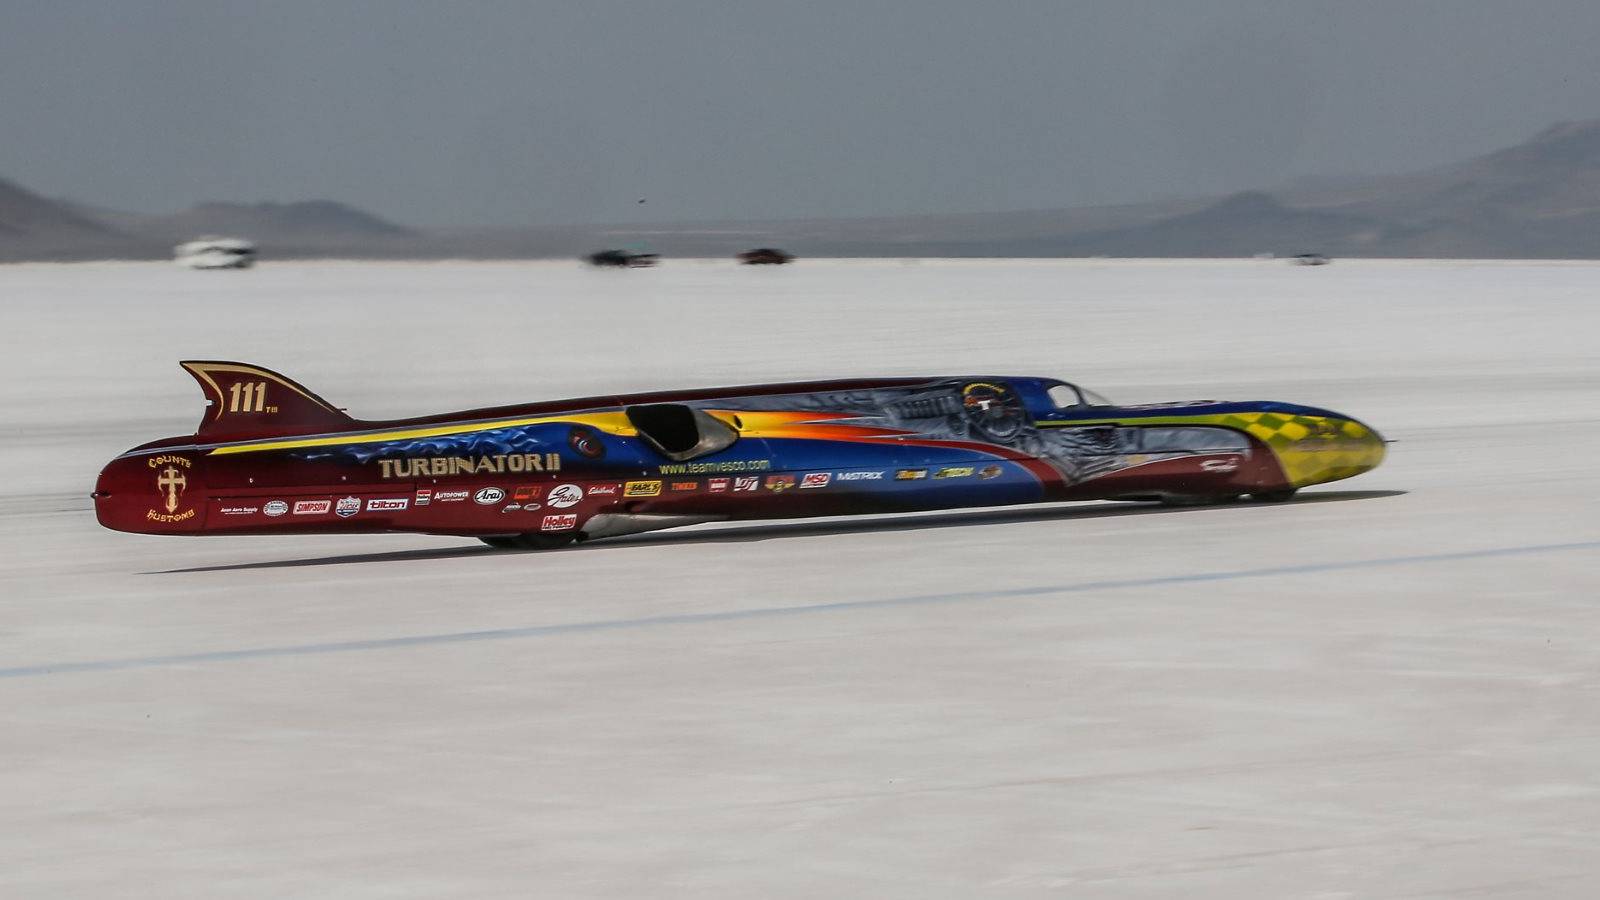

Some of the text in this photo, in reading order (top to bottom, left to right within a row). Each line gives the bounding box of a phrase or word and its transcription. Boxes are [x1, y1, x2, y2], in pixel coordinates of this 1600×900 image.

[230, 382, 266, 412] 111
[148, 455, 192, 468] COUNTS
[378, 453, 561, 478] TURBINATOR II
[659, 460, 771, 475] www.teamvesco.com
[477, 489, 501, 500] Arai
[296, 503, 328, 512] SIMPSON
[370, 500, 405, 509] tilton
[147, 508, 195, 522] KUSTOMS
[543, 515, 575, 527] Holley
